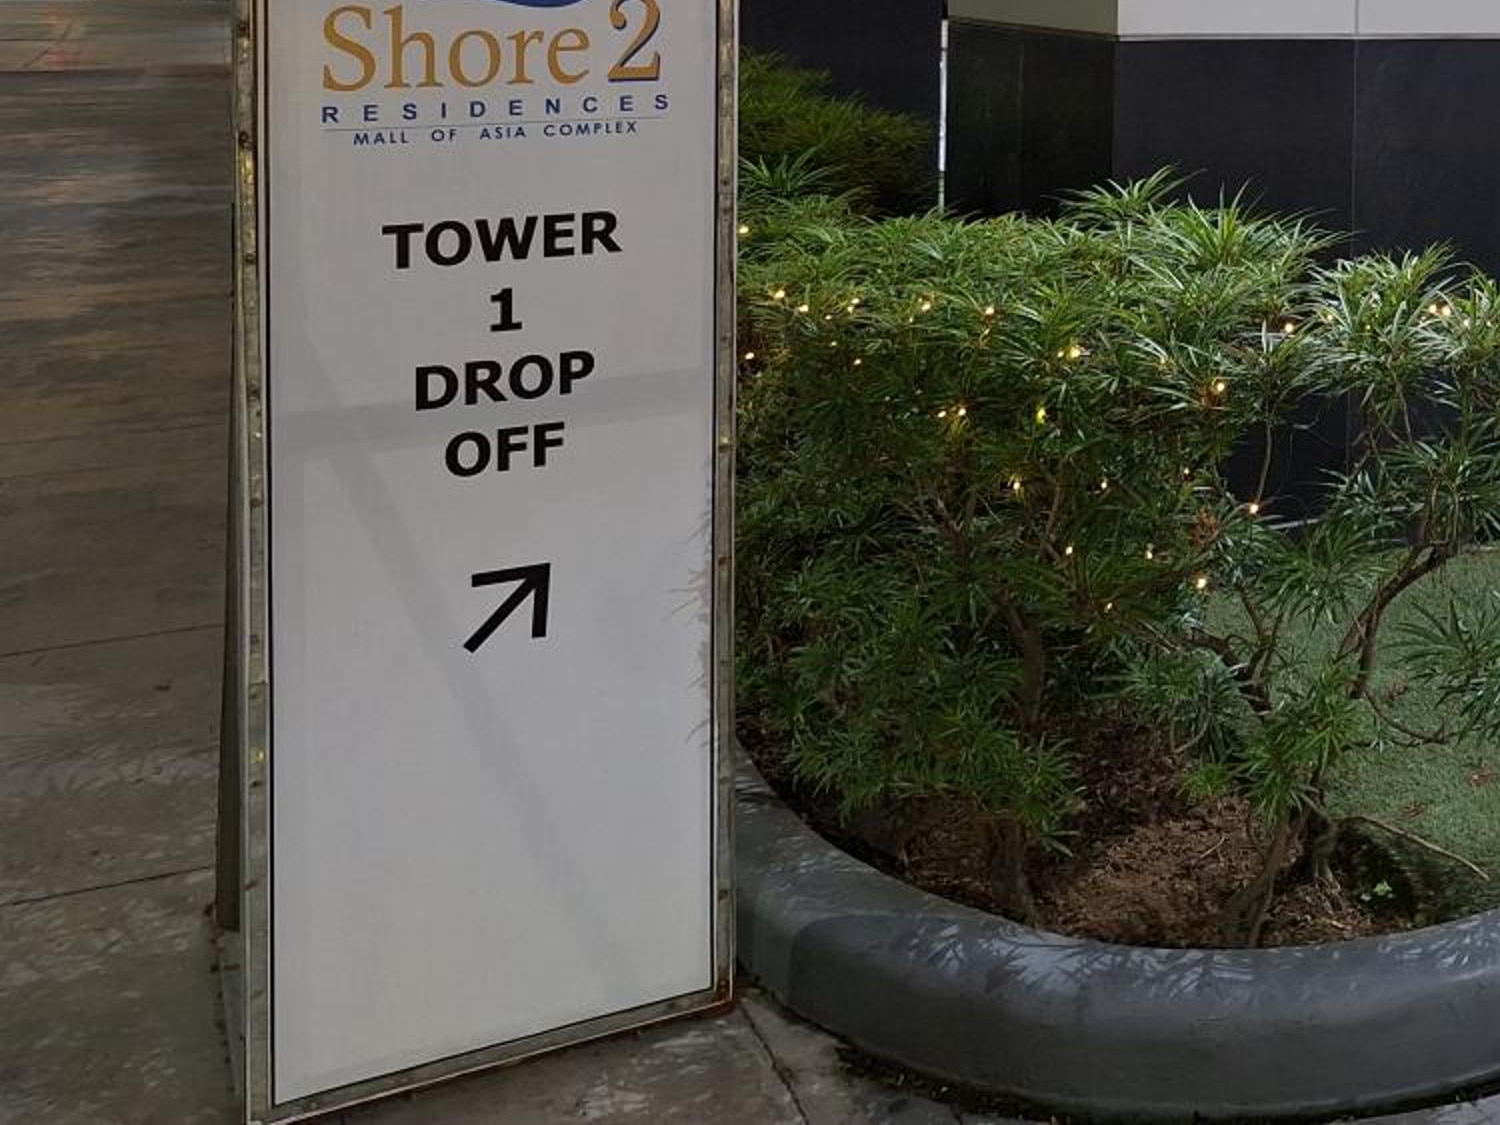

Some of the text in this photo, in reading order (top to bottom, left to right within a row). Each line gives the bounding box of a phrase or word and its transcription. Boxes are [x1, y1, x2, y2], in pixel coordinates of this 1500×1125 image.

[322, 4, 591, 92] Shore
[321, 93, 669, 124] RESIDENCES
[353, 121, 638, 147] MALL OF ASIA COMPLEX
[382, 211, 623, 269] TOWER
[489, 287, 523, 333] 1
[415, 350, 596, 412] DROP
[444, 420, 566, 478] OFF
